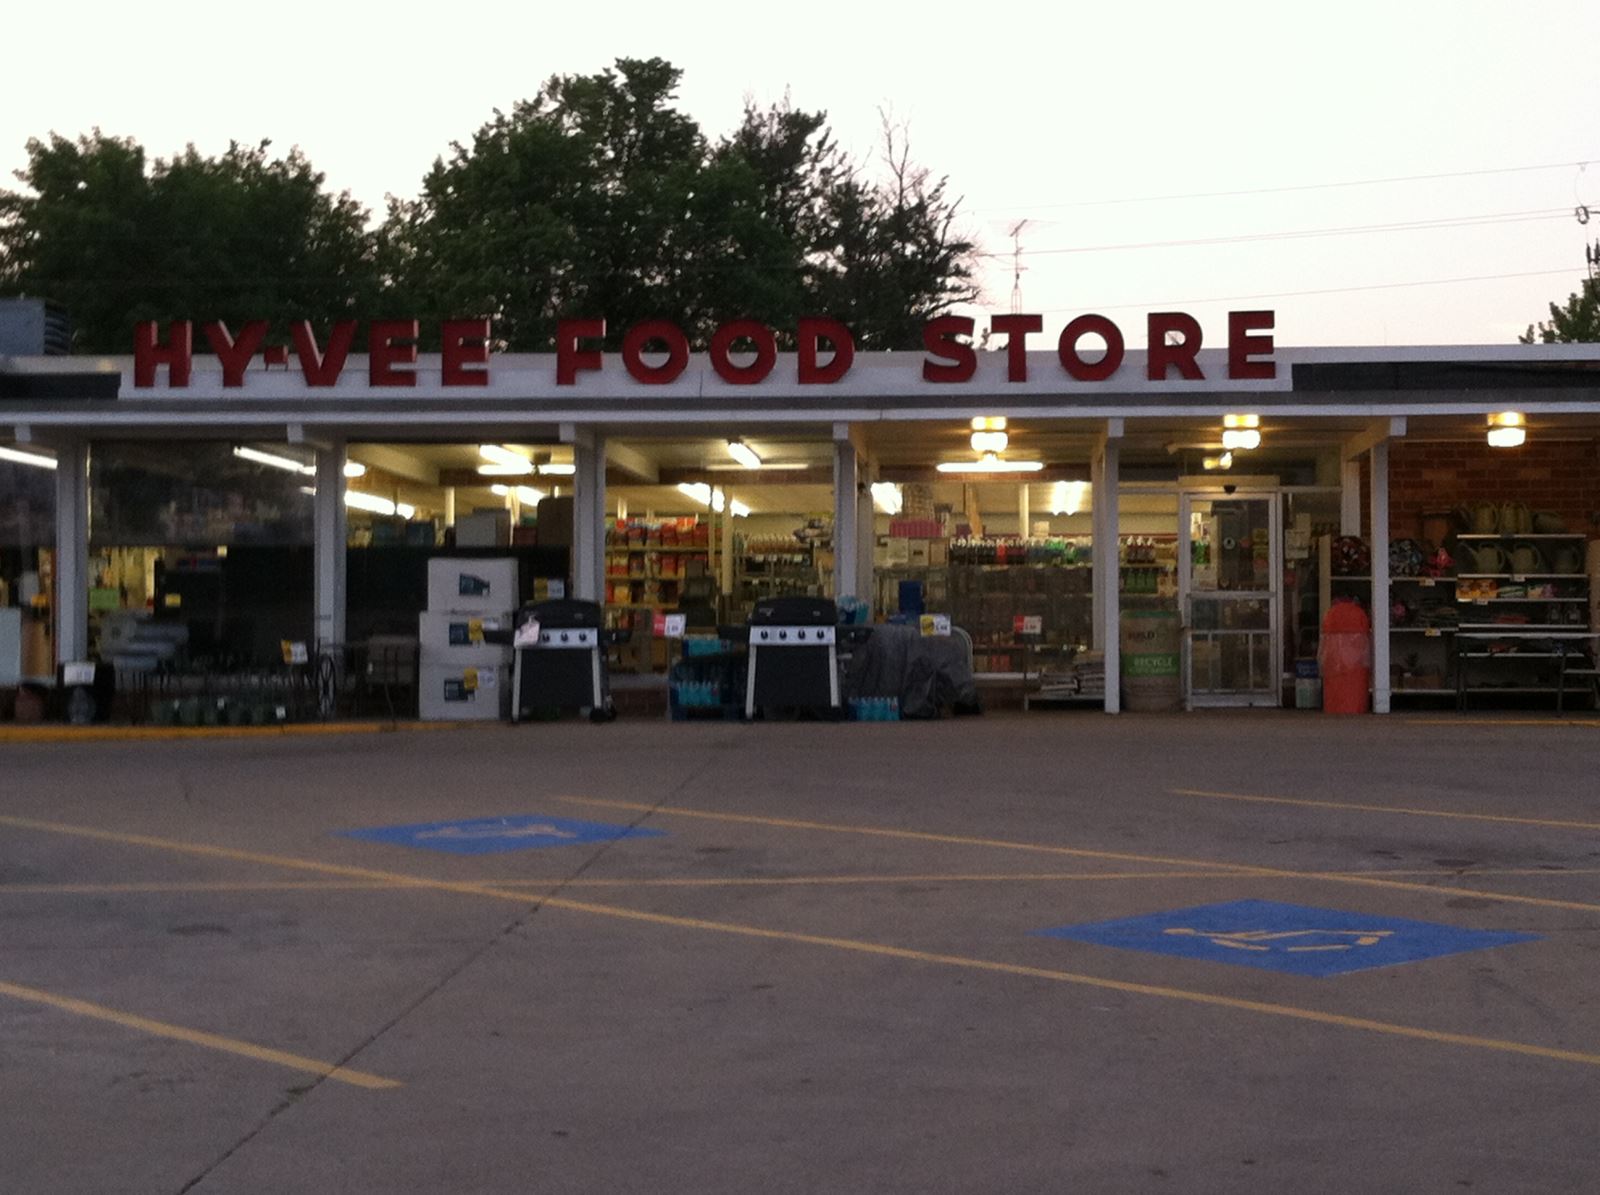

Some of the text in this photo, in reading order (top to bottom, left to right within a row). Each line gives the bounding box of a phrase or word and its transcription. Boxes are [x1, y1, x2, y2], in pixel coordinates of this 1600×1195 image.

[134, 310, 1276, 388] HY-VEE FOOD STORE
